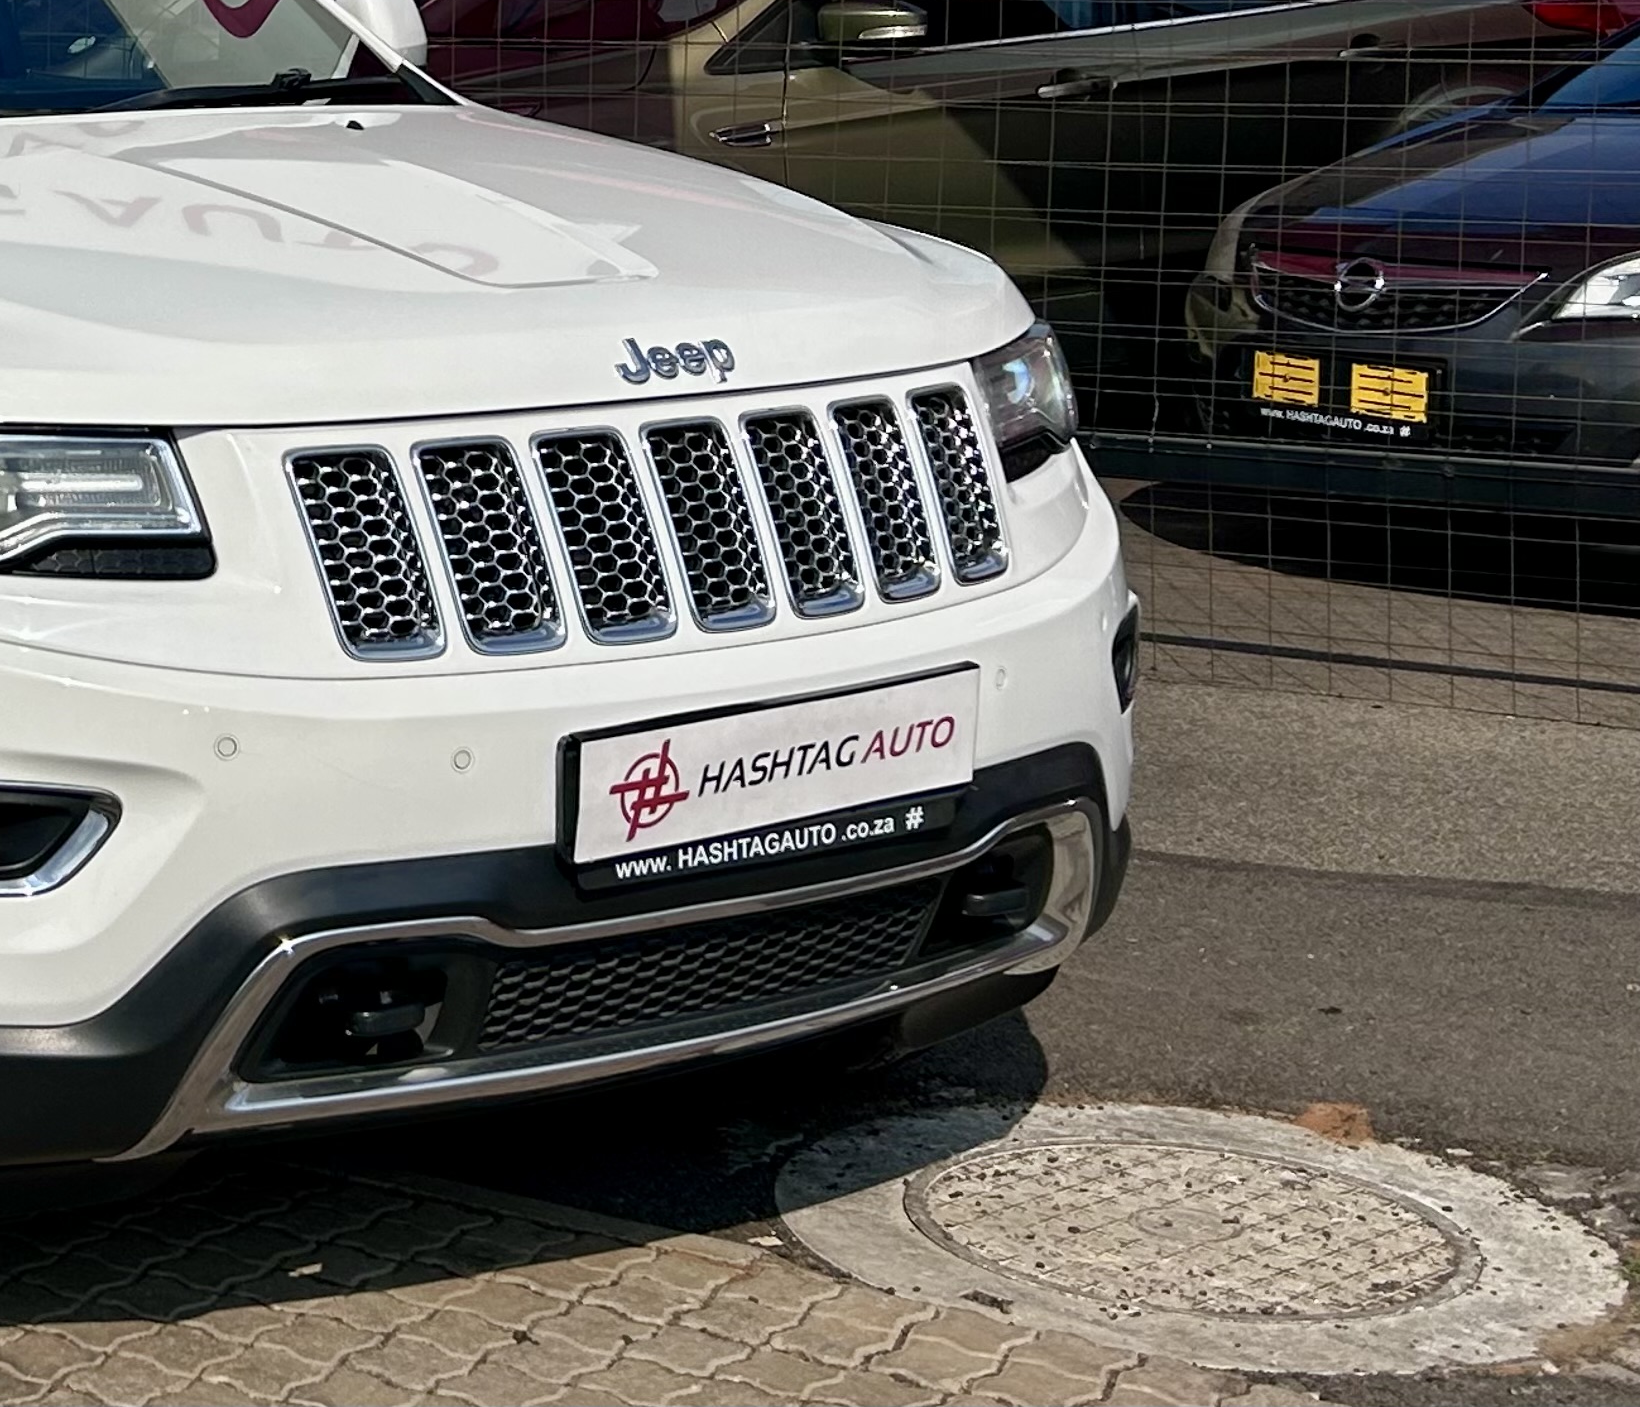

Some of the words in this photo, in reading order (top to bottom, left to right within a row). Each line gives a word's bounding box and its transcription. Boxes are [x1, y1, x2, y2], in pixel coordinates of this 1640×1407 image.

[614, 338, 735, 385] Jeep
[1286, 410, 1362, 430] HASHTAGAUTO
[698, 735, 860, 798] HASHTAG
[861, 715, 955, 764] AUTO
[615, 851, 672, 881] www.
[677, 822, 837, 871] HASHTAGAUTO
